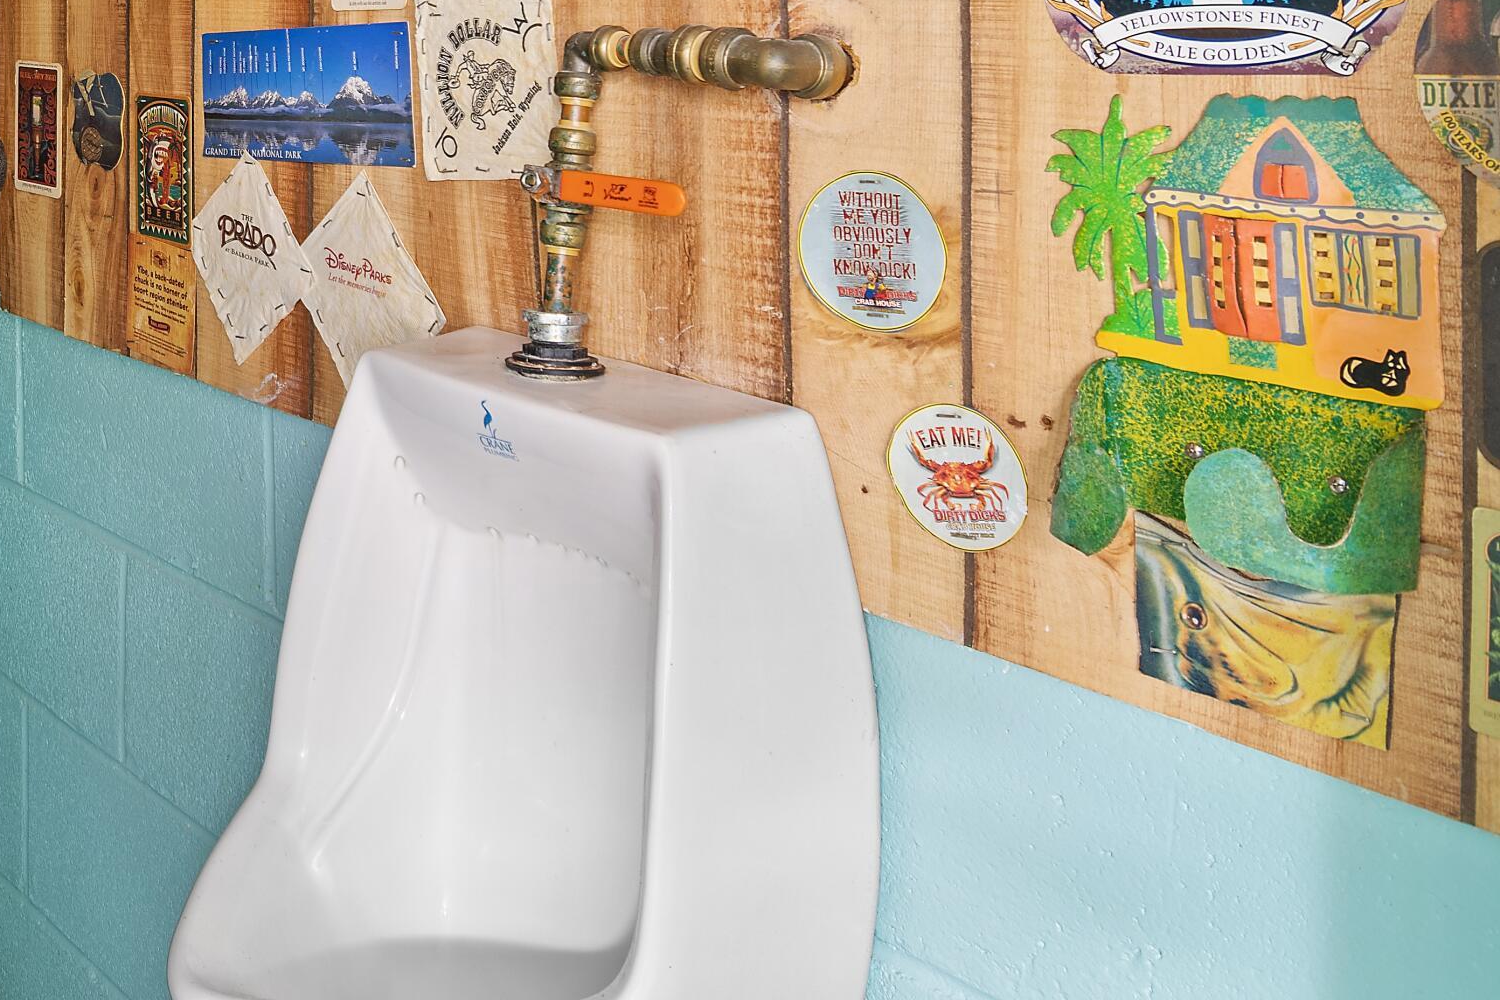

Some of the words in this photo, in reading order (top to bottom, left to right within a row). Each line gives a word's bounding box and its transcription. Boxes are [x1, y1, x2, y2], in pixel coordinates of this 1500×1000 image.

[1120, 11, 1255, 32] YELLOWSTONE'S
[1260, 11, 1324, 32] FINEST
[447, 17, 501, 51] DOLLAR
[1154, 42, 1198, 60] PALE
[1202, 42, 1288, 62] GOLDEN
[436, 46, 465, 129] MILLION
[1422, 82, 1496, 108] DIXIE
[1441, 112, 1456, 130] 100
[1453, 129, 1485, 163] YEARS
[205, 148, 228, 157] GRAND
[251, 148, 283, 159] NATIONAL
[285, 150, 301, 159] PARK
[839, 191, 901, 211] WITHOUT
[241, 213, 253, 222] THE
[842, 208, 865, 224] ME
[869, 209, 899, 226] YOU
[218, 215, 276, 256] PRADO
[833, 226, 911, 245] OBVIOUSLY
[853, 243, 893, 259] DON'T
[834, 259, 875, 276] KNOW
[878, 261, 917, 280] DICK!
[916, 427, 946, 449] EAT
[952, 427, 980, 448] ME!
[933, 510, 967, 522] DIRTY
